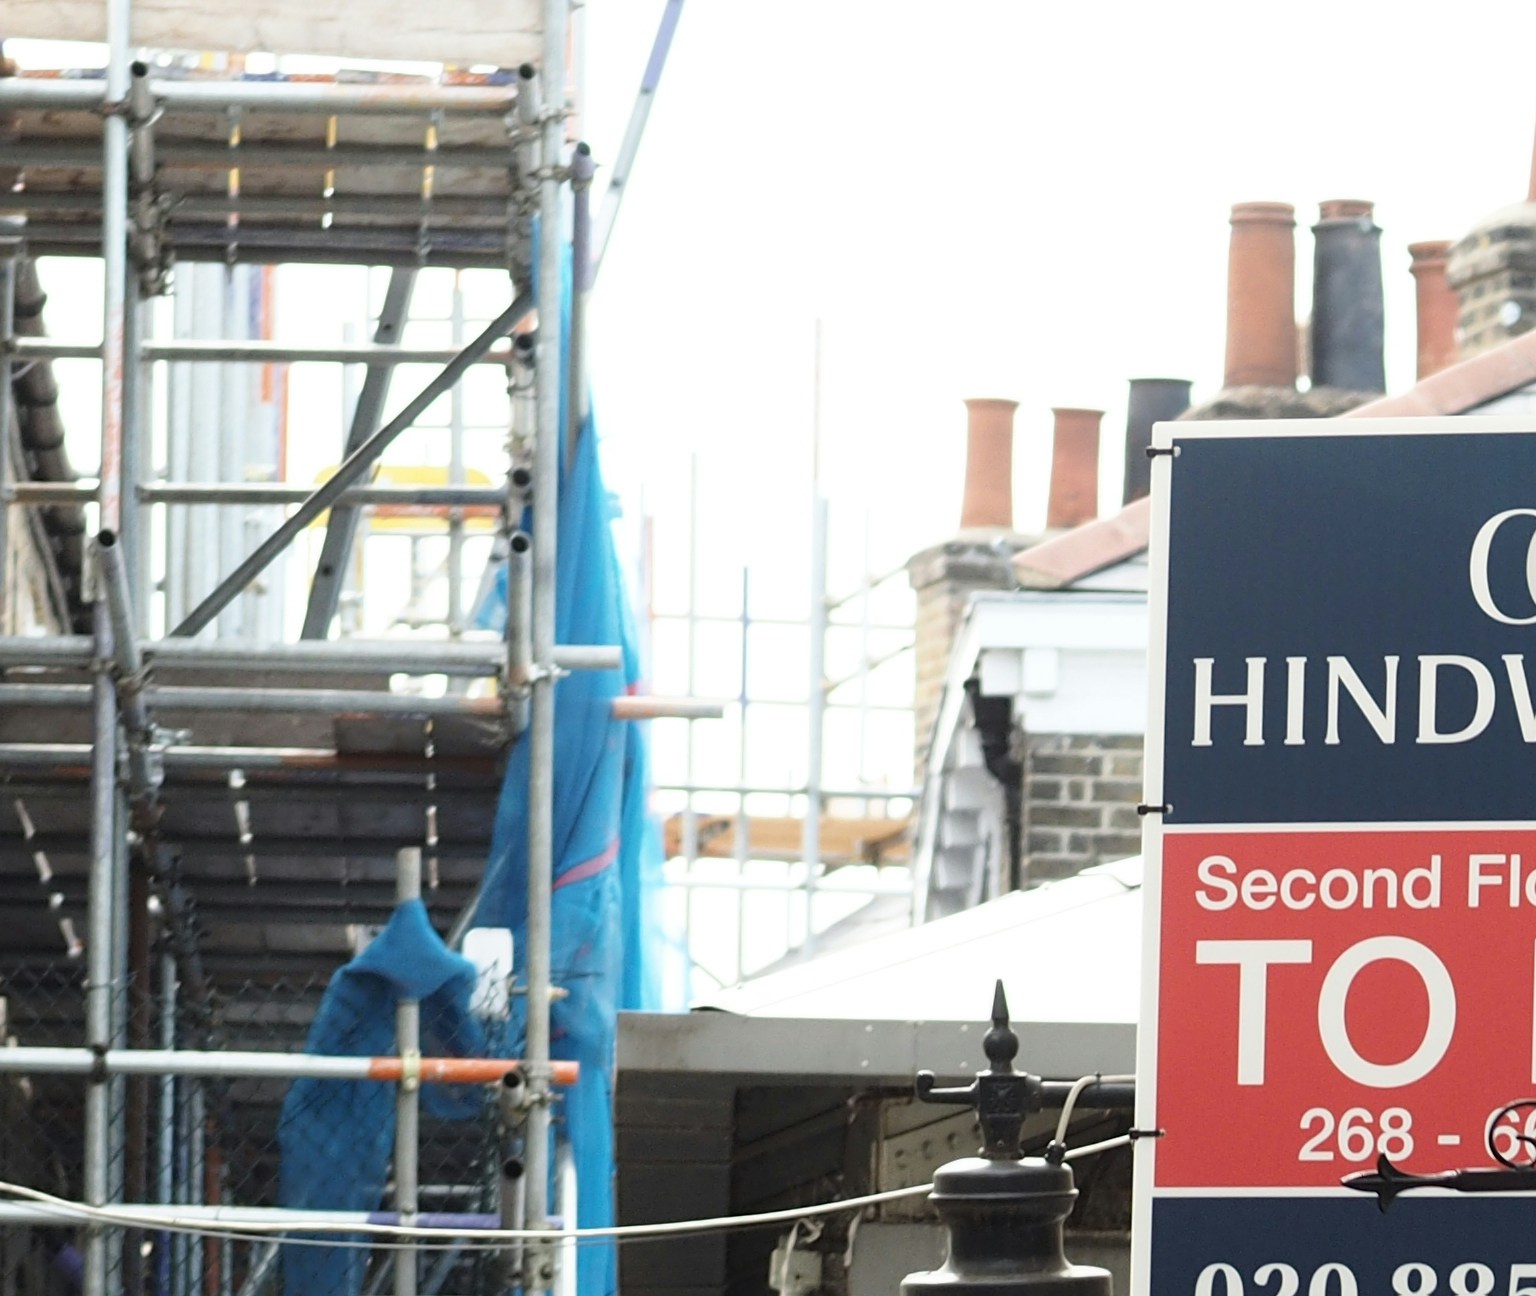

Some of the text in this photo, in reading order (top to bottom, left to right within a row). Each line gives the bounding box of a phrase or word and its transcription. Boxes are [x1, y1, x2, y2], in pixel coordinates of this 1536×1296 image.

[1195, 853, 1443, 912] Second
[1195, 934, 1458, 1089] TO
[1297, 1107, 1415, 1164] 268
[1436, 1134, 1461, 1147] -
